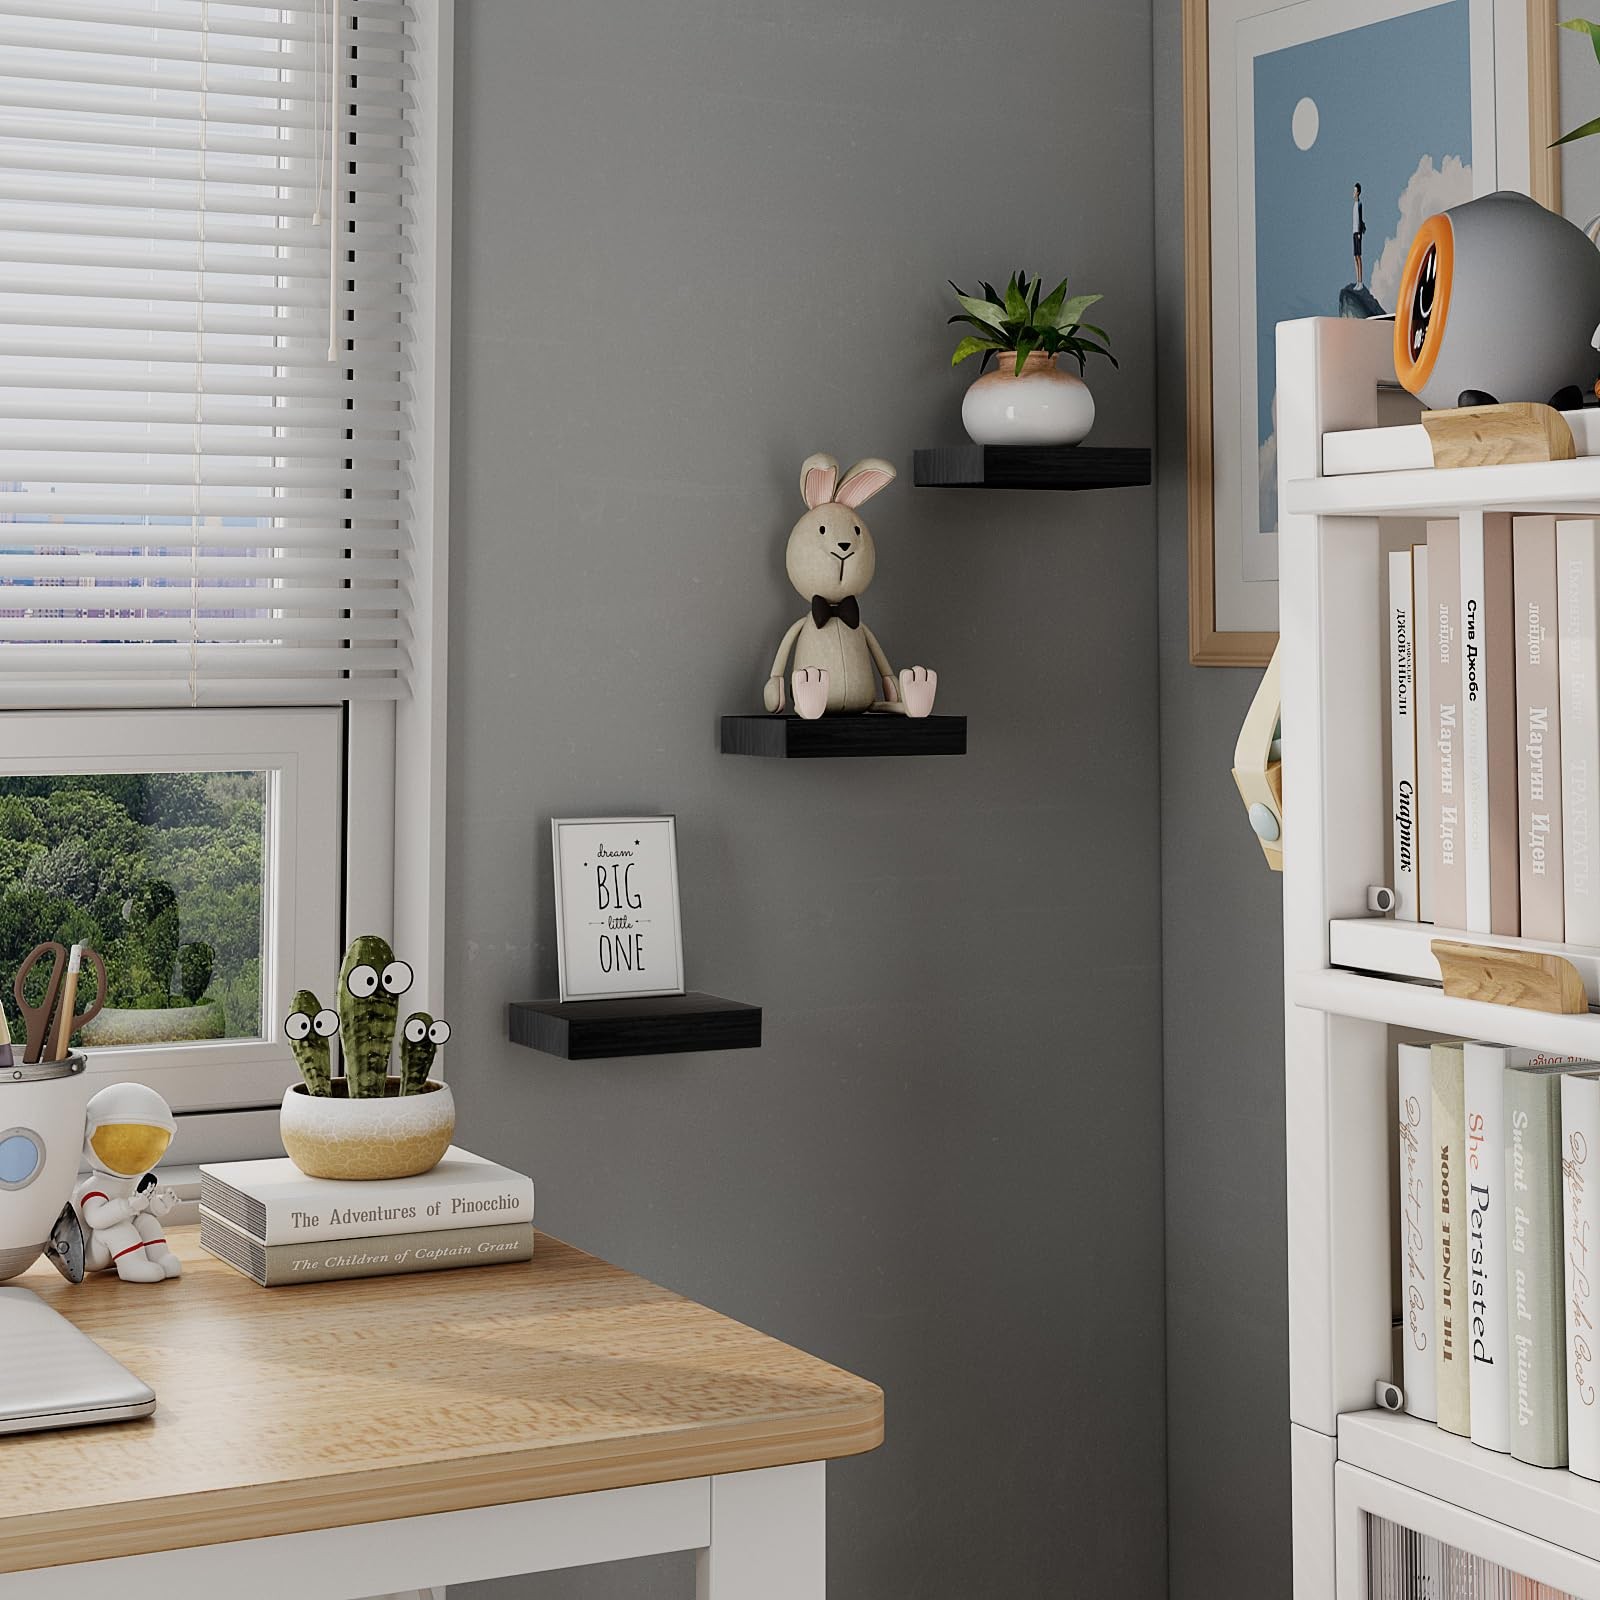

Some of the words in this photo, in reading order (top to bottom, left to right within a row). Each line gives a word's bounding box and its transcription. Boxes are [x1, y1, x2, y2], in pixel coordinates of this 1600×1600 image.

[1467, 599, 1477, 640] Стив
[1396, 608, 1407, 715] ДЖОВАНЬОЛИ
[1466, 644, 1479, 702] Джобс
[1437, 703, 1456, 794] Мартин
[1526, 706, 1548, 801] Мартин
[597, 843, 633, 858] dream
[1395, 780, 1414, 873] Спартак
[1440, 804, 1458, 865] Иден
[1529, 812, 1550, 875] Иден
[1570, 759, 1589, 896] ТРАКТАТЫ
[596, 863, 642, 910] BIG
[600, 933, 645, 973] ONE
[608, 915, 633, 929] little
[1400, 1096, 1423, 1224] Different
[1468, 1113, 1484, 1170] She
[1512, 1110, 1529, 1192] Smart
[291, 1212, 319, 1229] The
[329, 1205, 416, 1226] Adventures
[426, 1202, 441, 1217] of
[451, 1194, 520, 1214] Pinocchio
[1440, 1144, 1450, 1214] BOOK
[1562, 1131, 1590, 1268] Different
[292, 1259, 319, 1271] The
[324, 1252, 388, 1268] Children
[394, 1249, 411, 1264] of
[415, 1245, 472, 1260] Captain
[477, 1240, 519, 1253] Grant
[1404, 1208, 1425, 1280] Like
[1512, 1206, 1530, 1255] dog
[1442, 1221, 1452, 1310] JUNGLE
[1470, 1183, 1494, 1365] Persisted
[1515, 1269, 1532, 1321] and
[1569, 1253, 1593, 1330] Like
[1408, 1285, 1427, 1351] Coco
[1443, 1316, 1453, 1363] THE
[1515, 1334, 1534, 1426] friends
[1573, 1334, 1595, 1405] Coco
